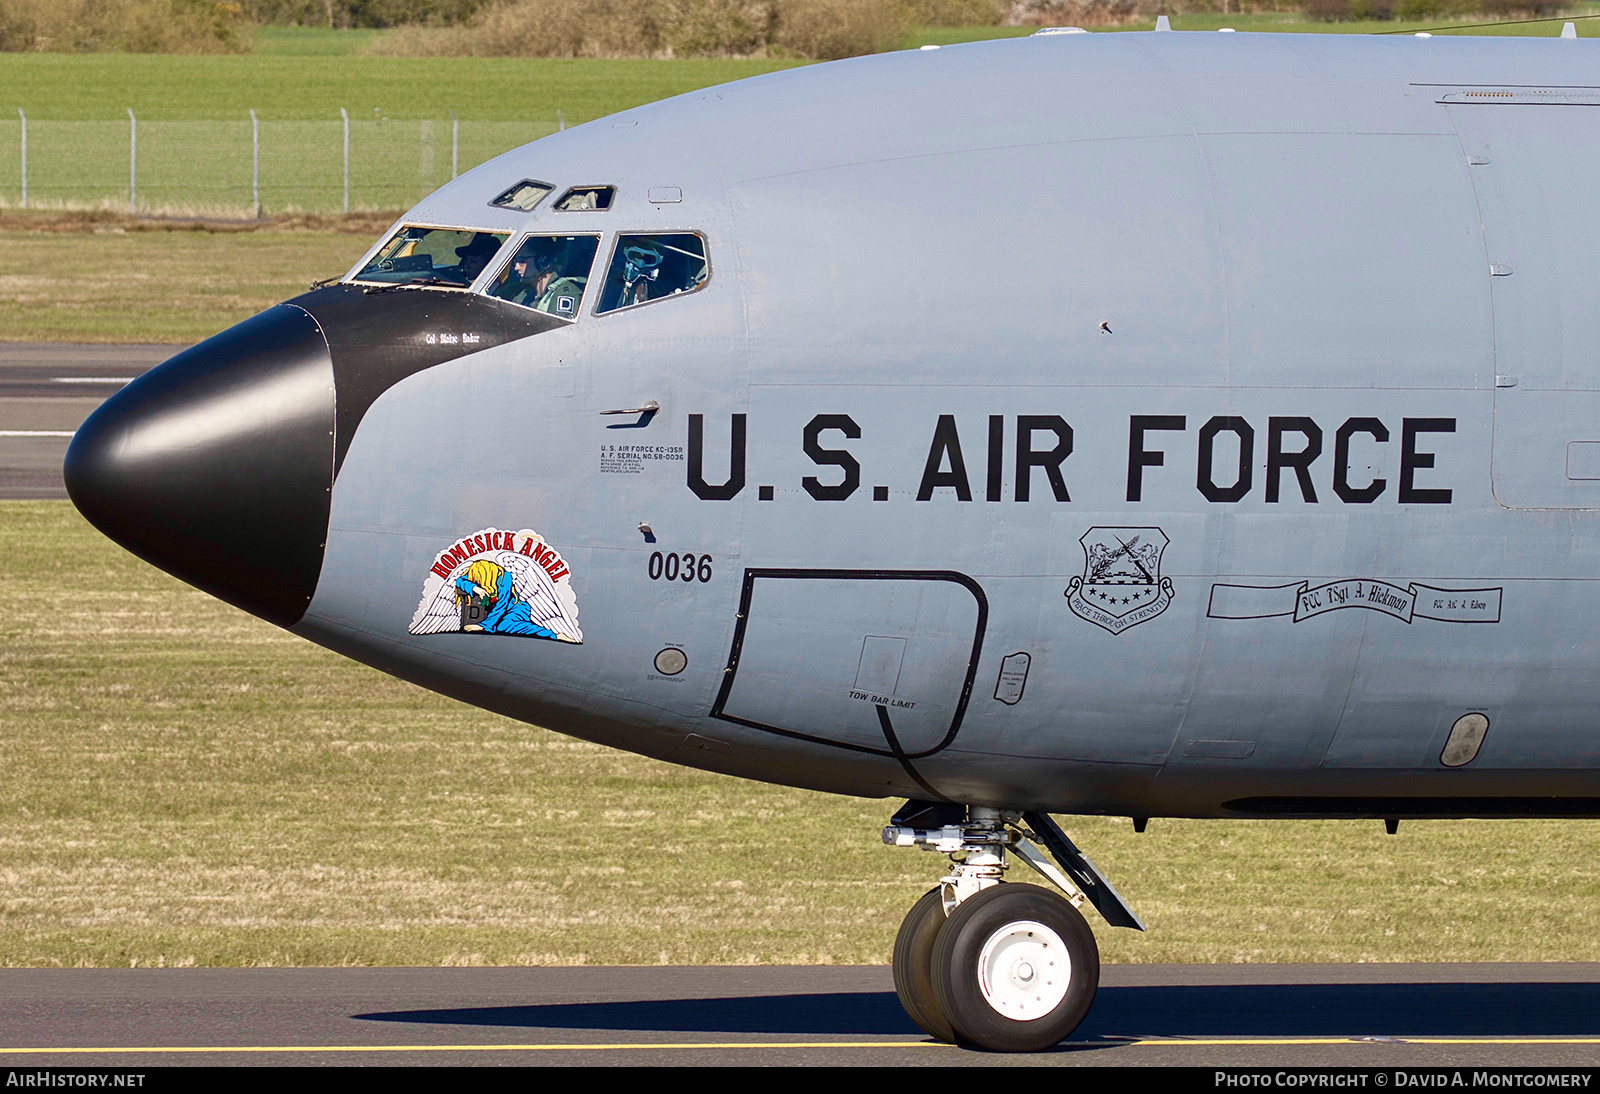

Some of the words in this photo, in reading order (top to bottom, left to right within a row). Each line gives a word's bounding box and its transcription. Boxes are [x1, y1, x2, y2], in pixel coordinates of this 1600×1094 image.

[916, 415, 1073, 502] AIR
[1126, 415, 1456, 503] FORCE
[430, 532, 516, 580] HOMESICK
[519, 537, 569, 583] ANGEL
[648, 551, 713, 583] 0036
[1072, 597, 1093, 616] PEACE
[1092, 611, 1127, 629] THROUGH
[1128, 597, 1167, 622] STRENGTH
[1302, 592, 1322, 612] FCC
[1326, 585, 1349, 604] TSgt
[1354, 581, 1365, 598] A.
[1367, 584, 1408, 613] Hickman
[849, 691, 868, 700] TOW
[870, 695, 890, 705] BAR
[891, 699, 916, 709] LIMIT
